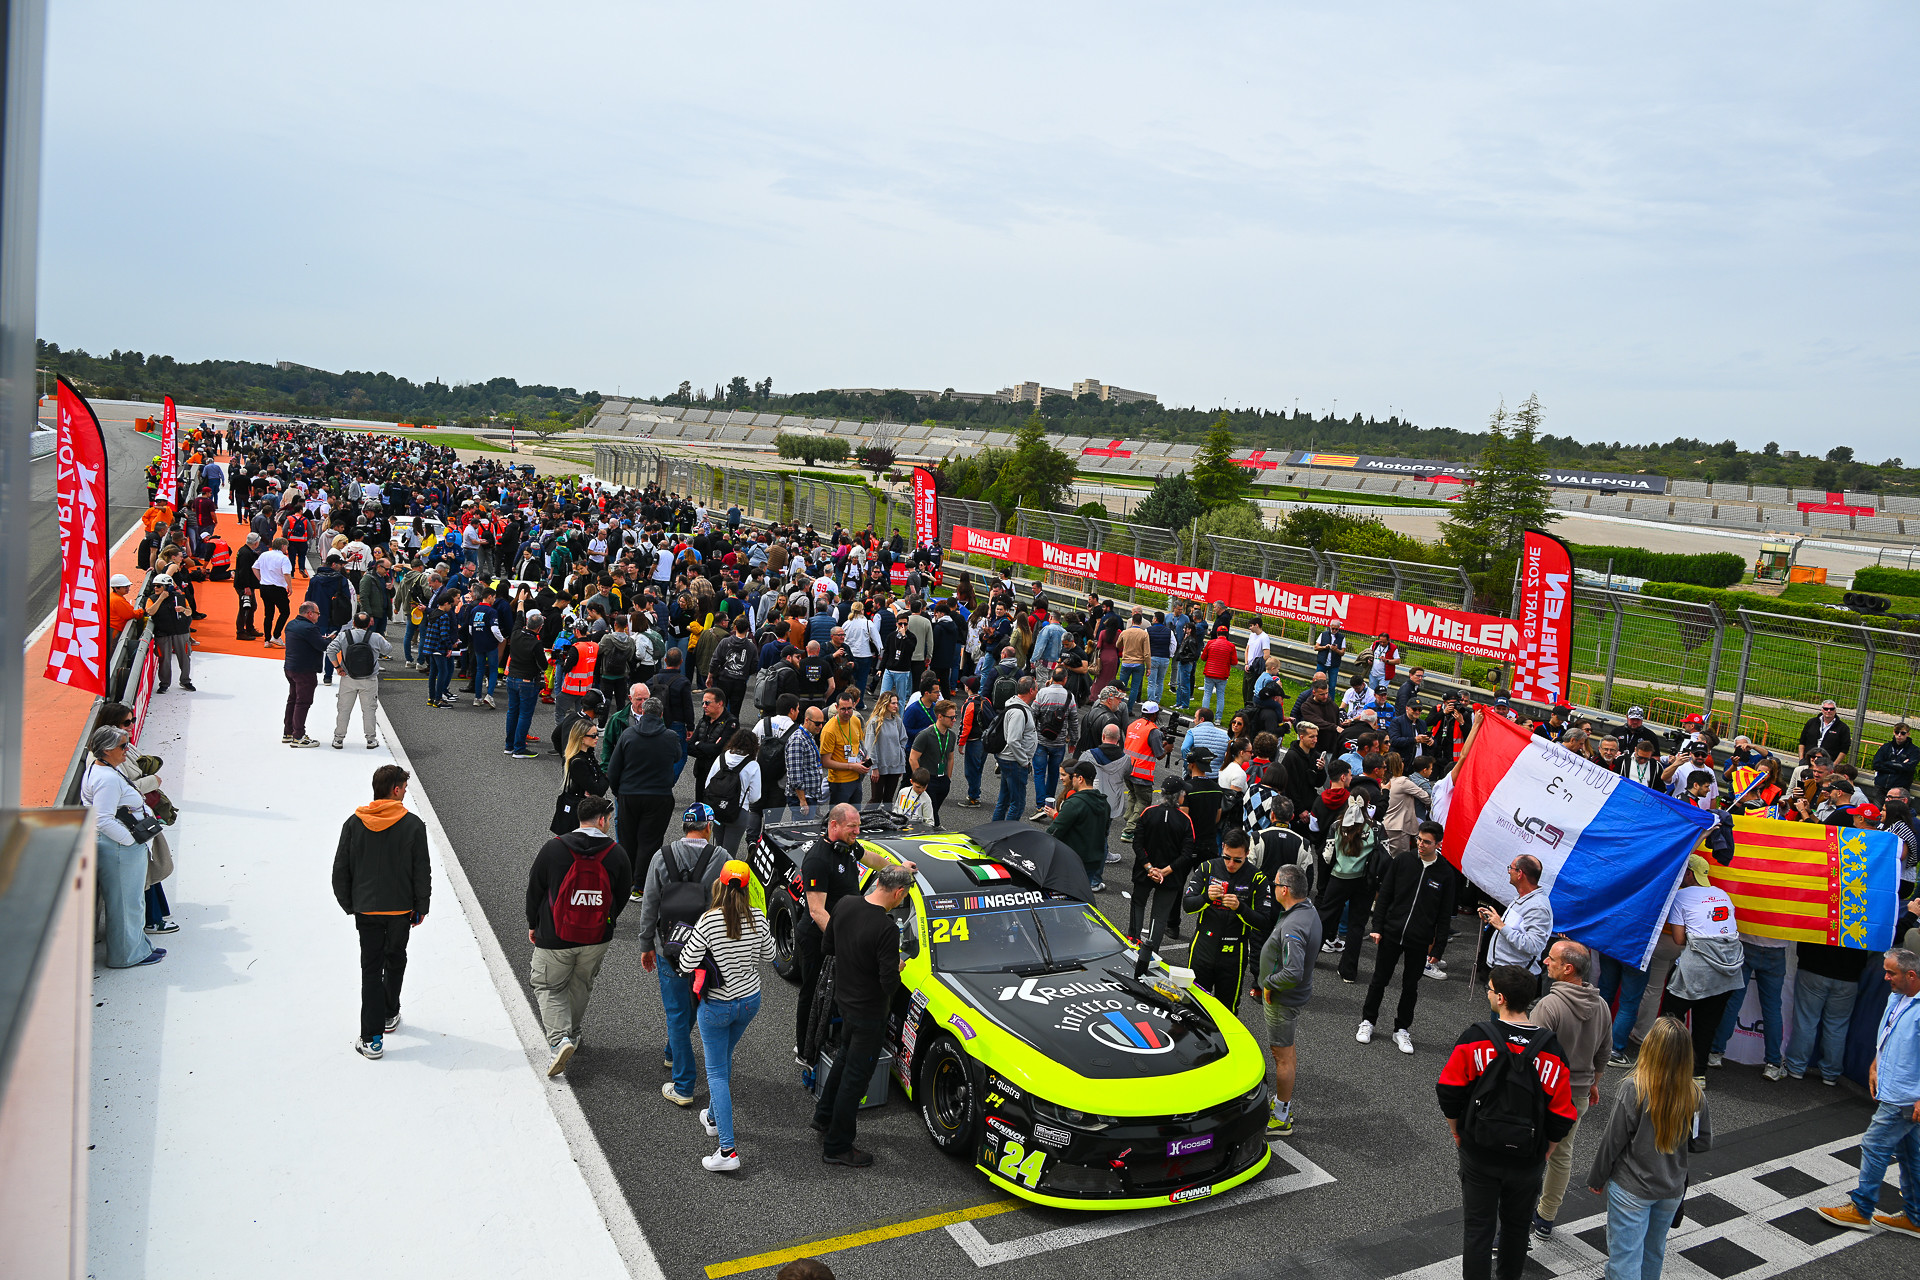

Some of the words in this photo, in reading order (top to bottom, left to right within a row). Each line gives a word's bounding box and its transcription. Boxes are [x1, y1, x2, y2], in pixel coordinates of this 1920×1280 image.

[1556, 475, 1650, 489] VALENCIA
[967, 530, 1011, 553] WHELEN
[1042, 541, 1101, 571] WHELEN
[1042, 563, 1068, 573] ENGINEERING
[1067, 567, 1088, 577] COMPANY
[1133, 558, 1210, 594] WHELEN
[816, 582, 828, 593] 99
[1135, 581, 1167, 593] ENGINEERING
[1167, 588, 1194, 599] COMPANY
[1194, 593, 1206, 601] INC.
[1253, 579, 1349, 619] WHELEN
[1255, 606, 1296, 620] ENGINEERING
[1296, 613, 1331, 626] COMPANY
[1405, 604, 1519, 650] WHELEN
[1408, 634, 1462, 651] ENGINEERING
[1463, 645, 1507, 660] COMPANY
[570, 889, 603, 906] VANS
[984, 890, 1045, 909] NASCAR
[1711, 905, 1729, 922] 3
[932, 917, 970, 944] 24
[1221, 945, 1235, 953] 24
[1473, 1048, 1496, 1072] NE
[996, 1080, 1021, 1100] quatra
[987, 1118, 1027, 1143] KENNOL
[1181, 1138, 1211, 1150] HOOSIER
[998, 1140, 1047, 1189] 24
[1172, 1185, 1212, 1201] KENNOL
